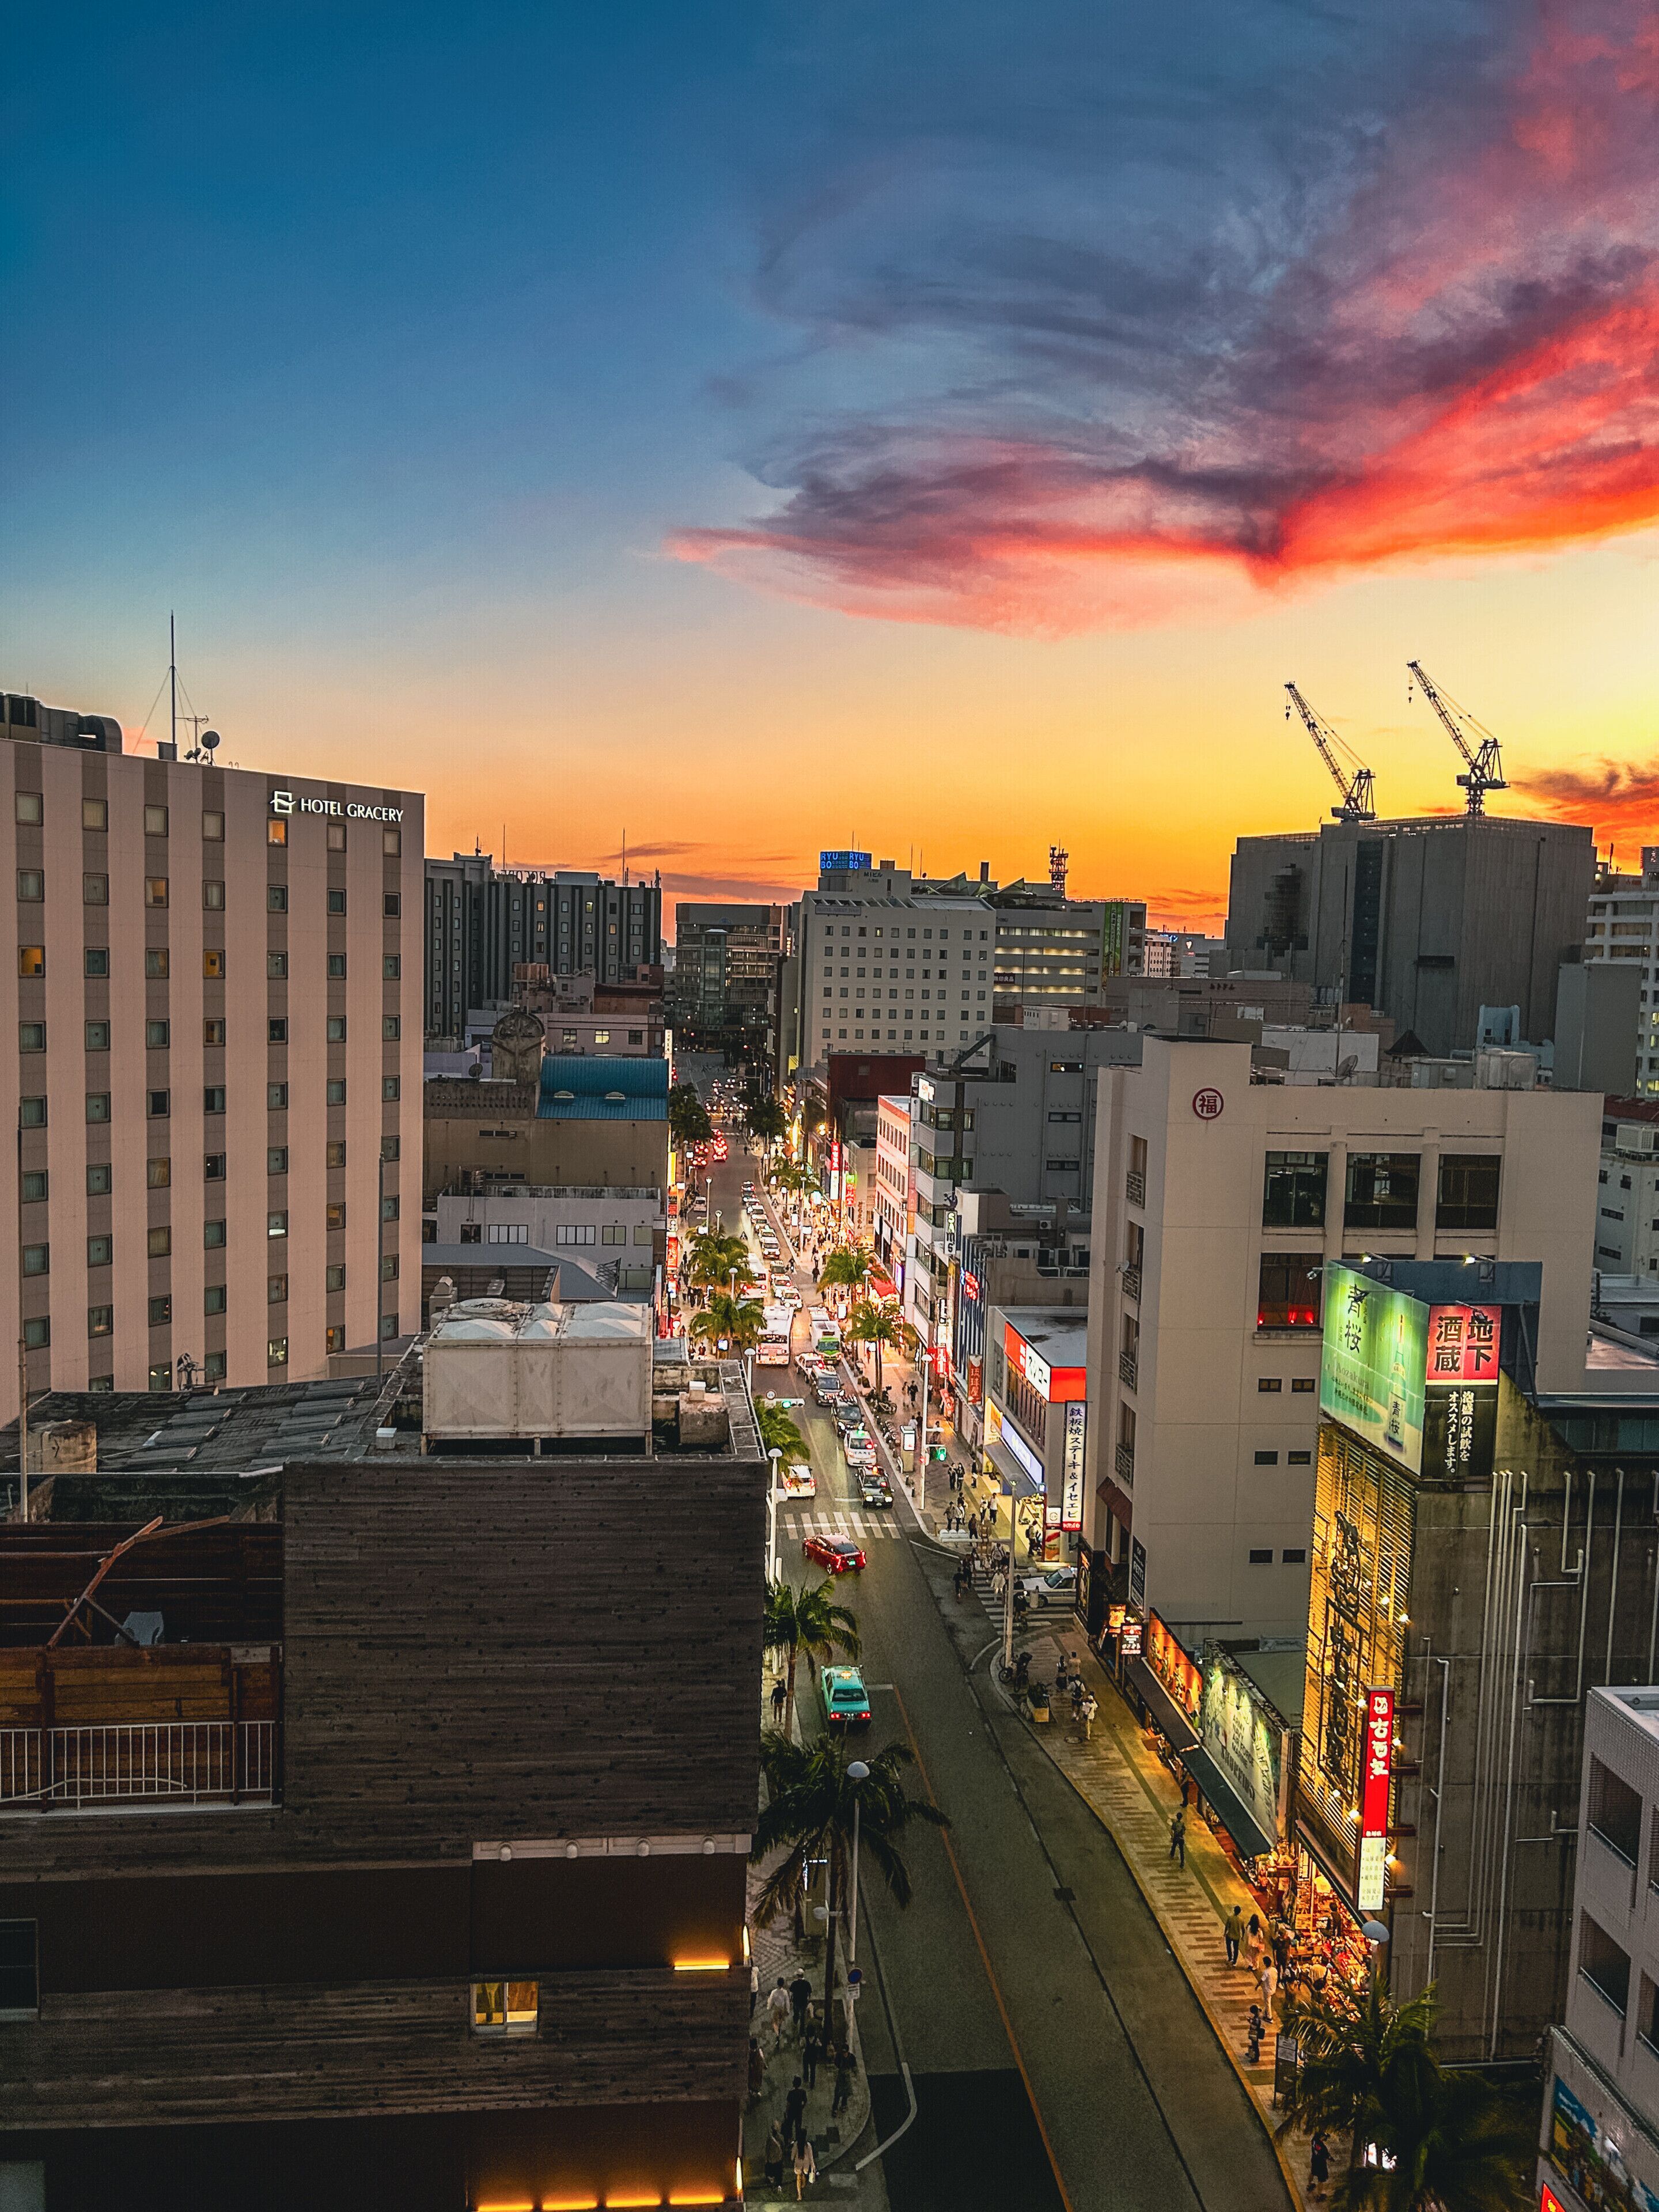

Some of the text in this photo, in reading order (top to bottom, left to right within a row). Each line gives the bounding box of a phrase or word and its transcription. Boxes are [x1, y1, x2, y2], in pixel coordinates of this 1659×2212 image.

[300, 797, 404, 822] HOTEL GRACERY
[820, 853, 838, 861] RYU
[821, 861, 832, 869] BO
[849, 853, 864, 861] RYU
[1434, 1315, 1464, 1372] 酒蔵
[1467, 1315, 1494, 1372] 地下
[1445, 1391, 1459, 1474] オススメします。
[1459, 1391, 1475, 1461] 泡盛の試飲を
